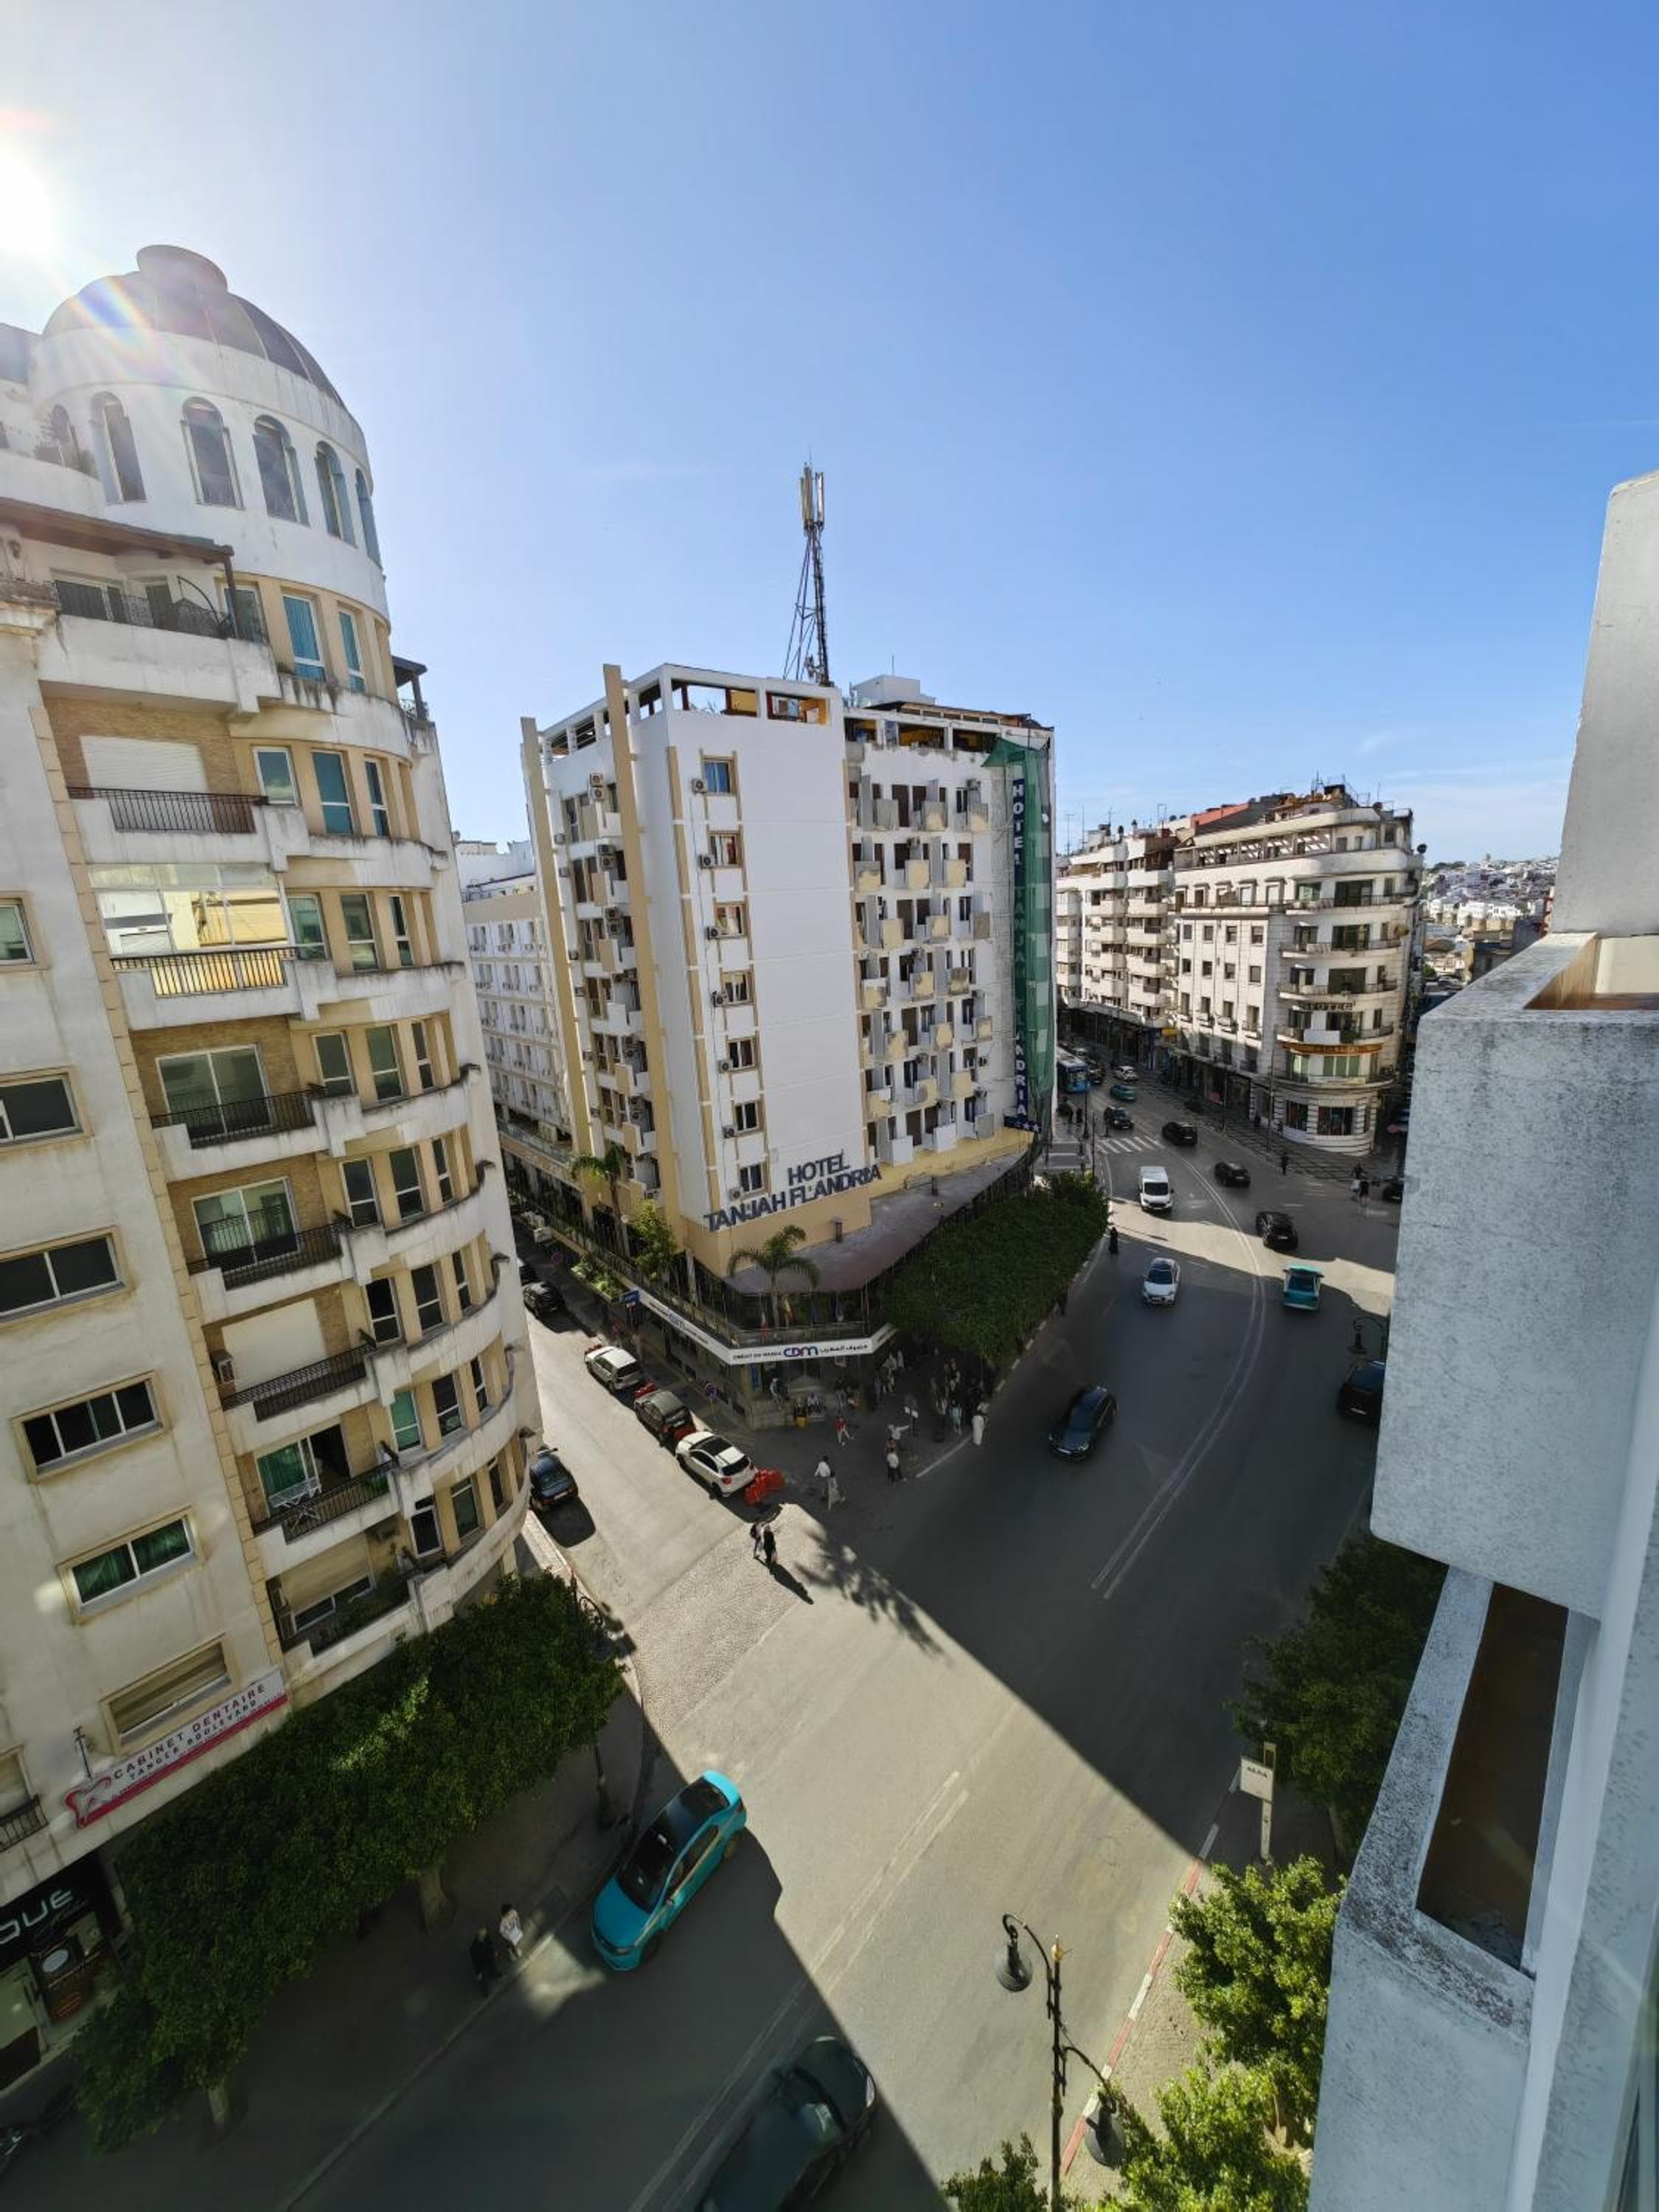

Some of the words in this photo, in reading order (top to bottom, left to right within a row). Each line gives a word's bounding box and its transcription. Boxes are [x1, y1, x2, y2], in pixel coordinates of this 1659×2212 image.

[787, 1151, 850, 1186] HOTEL
[703, 1192, 787, 1231] TANJAH
[790, 1164, 882, 1206] FLANDRIA
[783, 1346, 818, 1357] CDM
[114, 1732, 186, 1779] CABINET
[192, 1683, 266, 1733] DENTAIRE
[187, 1699, 258, 1747] BOULEVARD
